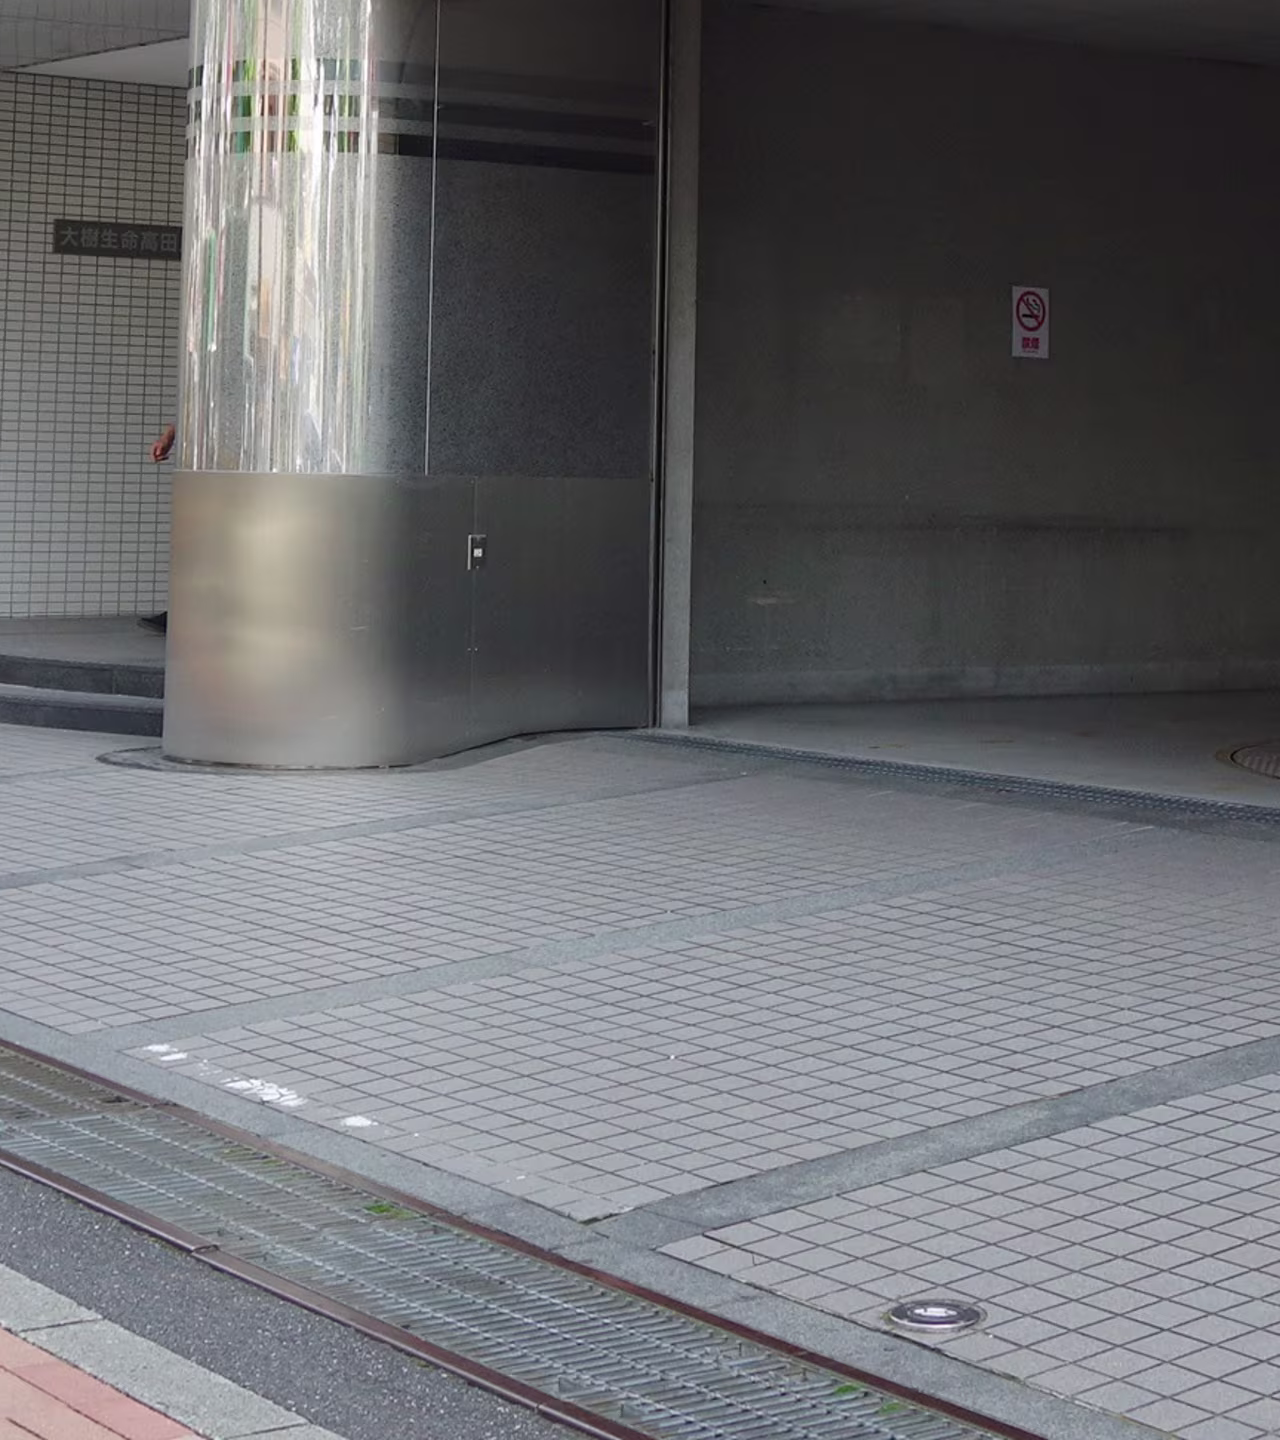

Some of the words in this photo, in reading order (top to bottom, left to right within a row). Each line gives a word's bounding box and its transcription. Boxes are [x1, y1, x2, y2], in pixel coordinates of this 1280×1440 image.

[60, 226, 178, 252] 大樹生命高田
